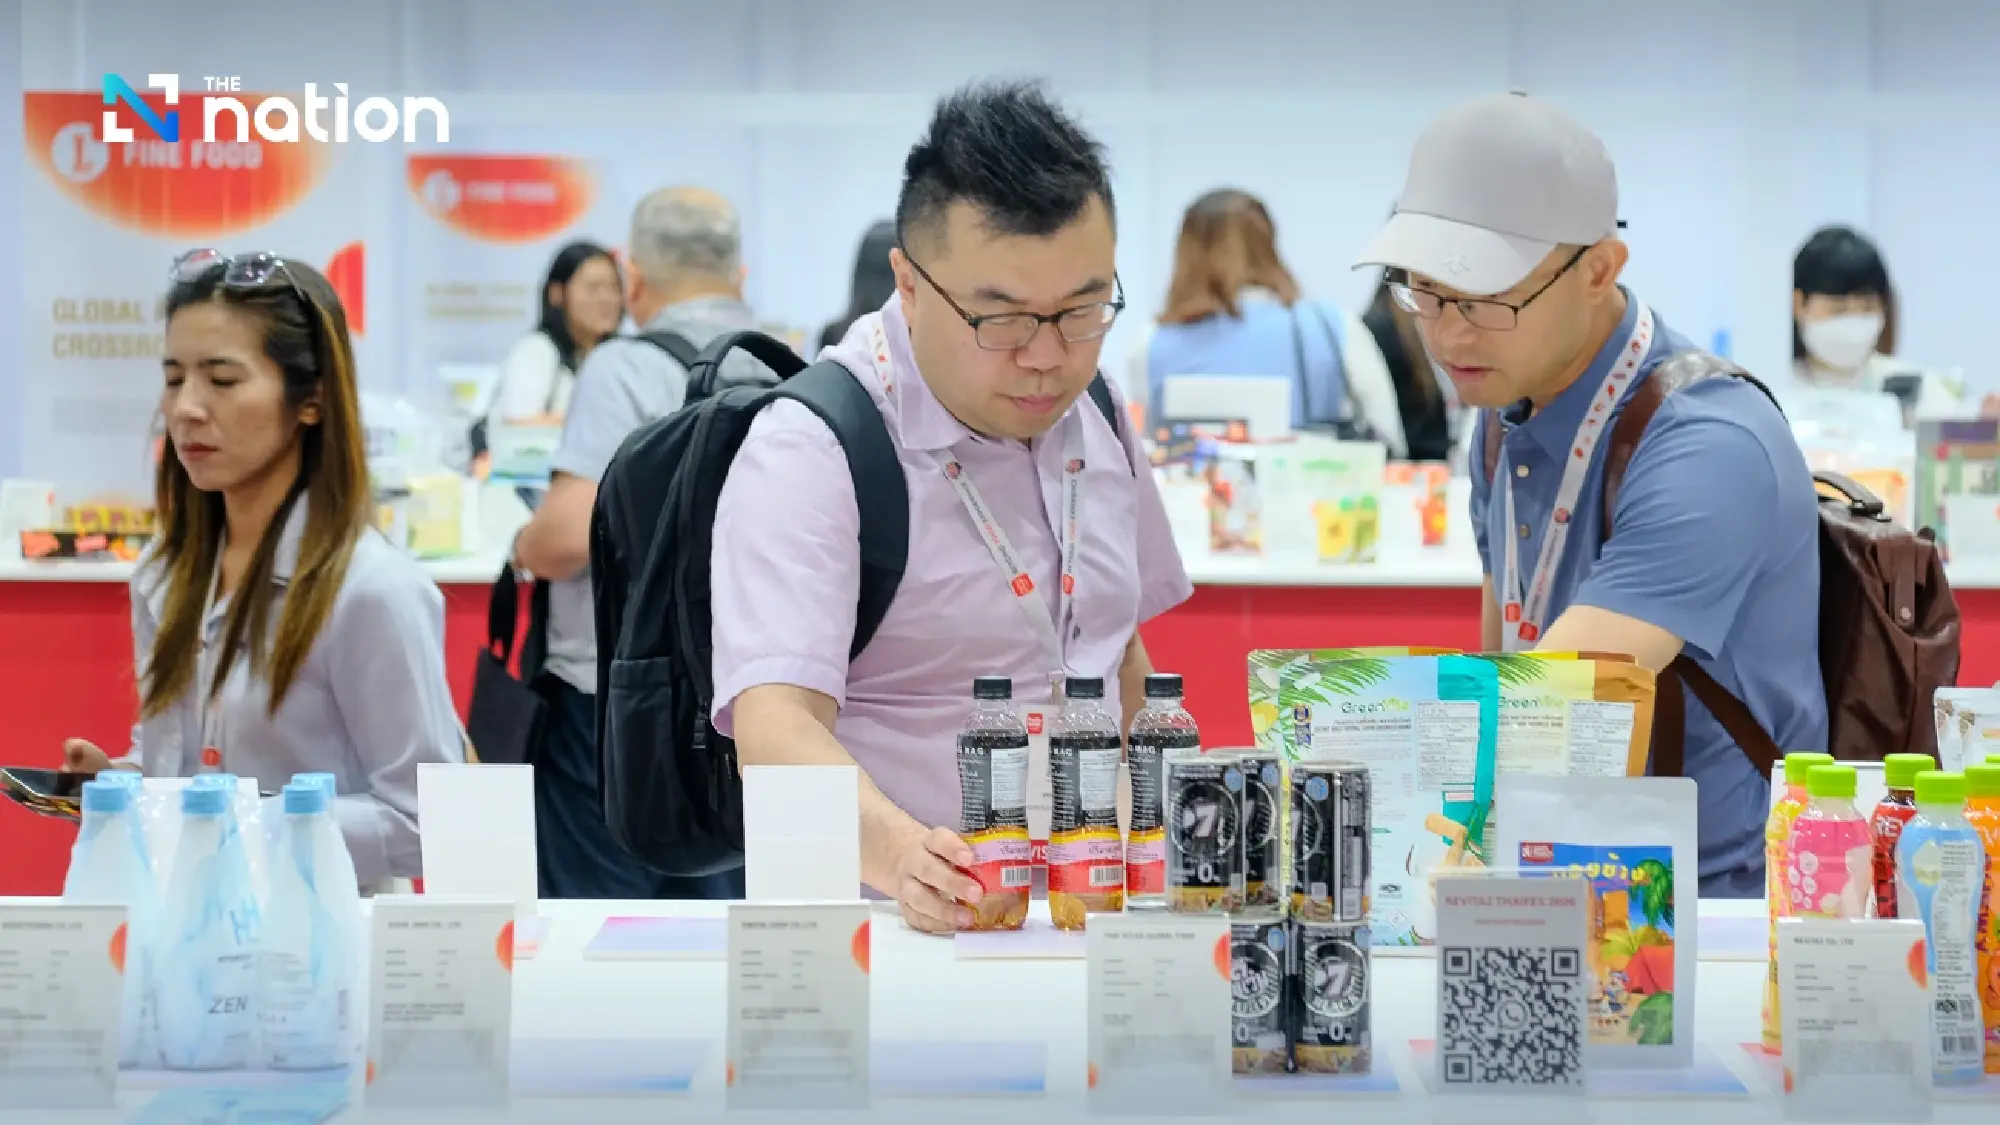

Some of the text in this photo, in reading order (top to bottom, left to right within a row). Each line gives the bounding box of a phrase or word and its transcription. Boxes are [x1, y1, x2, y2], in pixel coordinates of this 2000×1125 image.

[123, 139, 263, 169] FINE FOOD
[53, 298, 147, 324] GLOBAL
[208, 996, 249, 1014] ZEN
